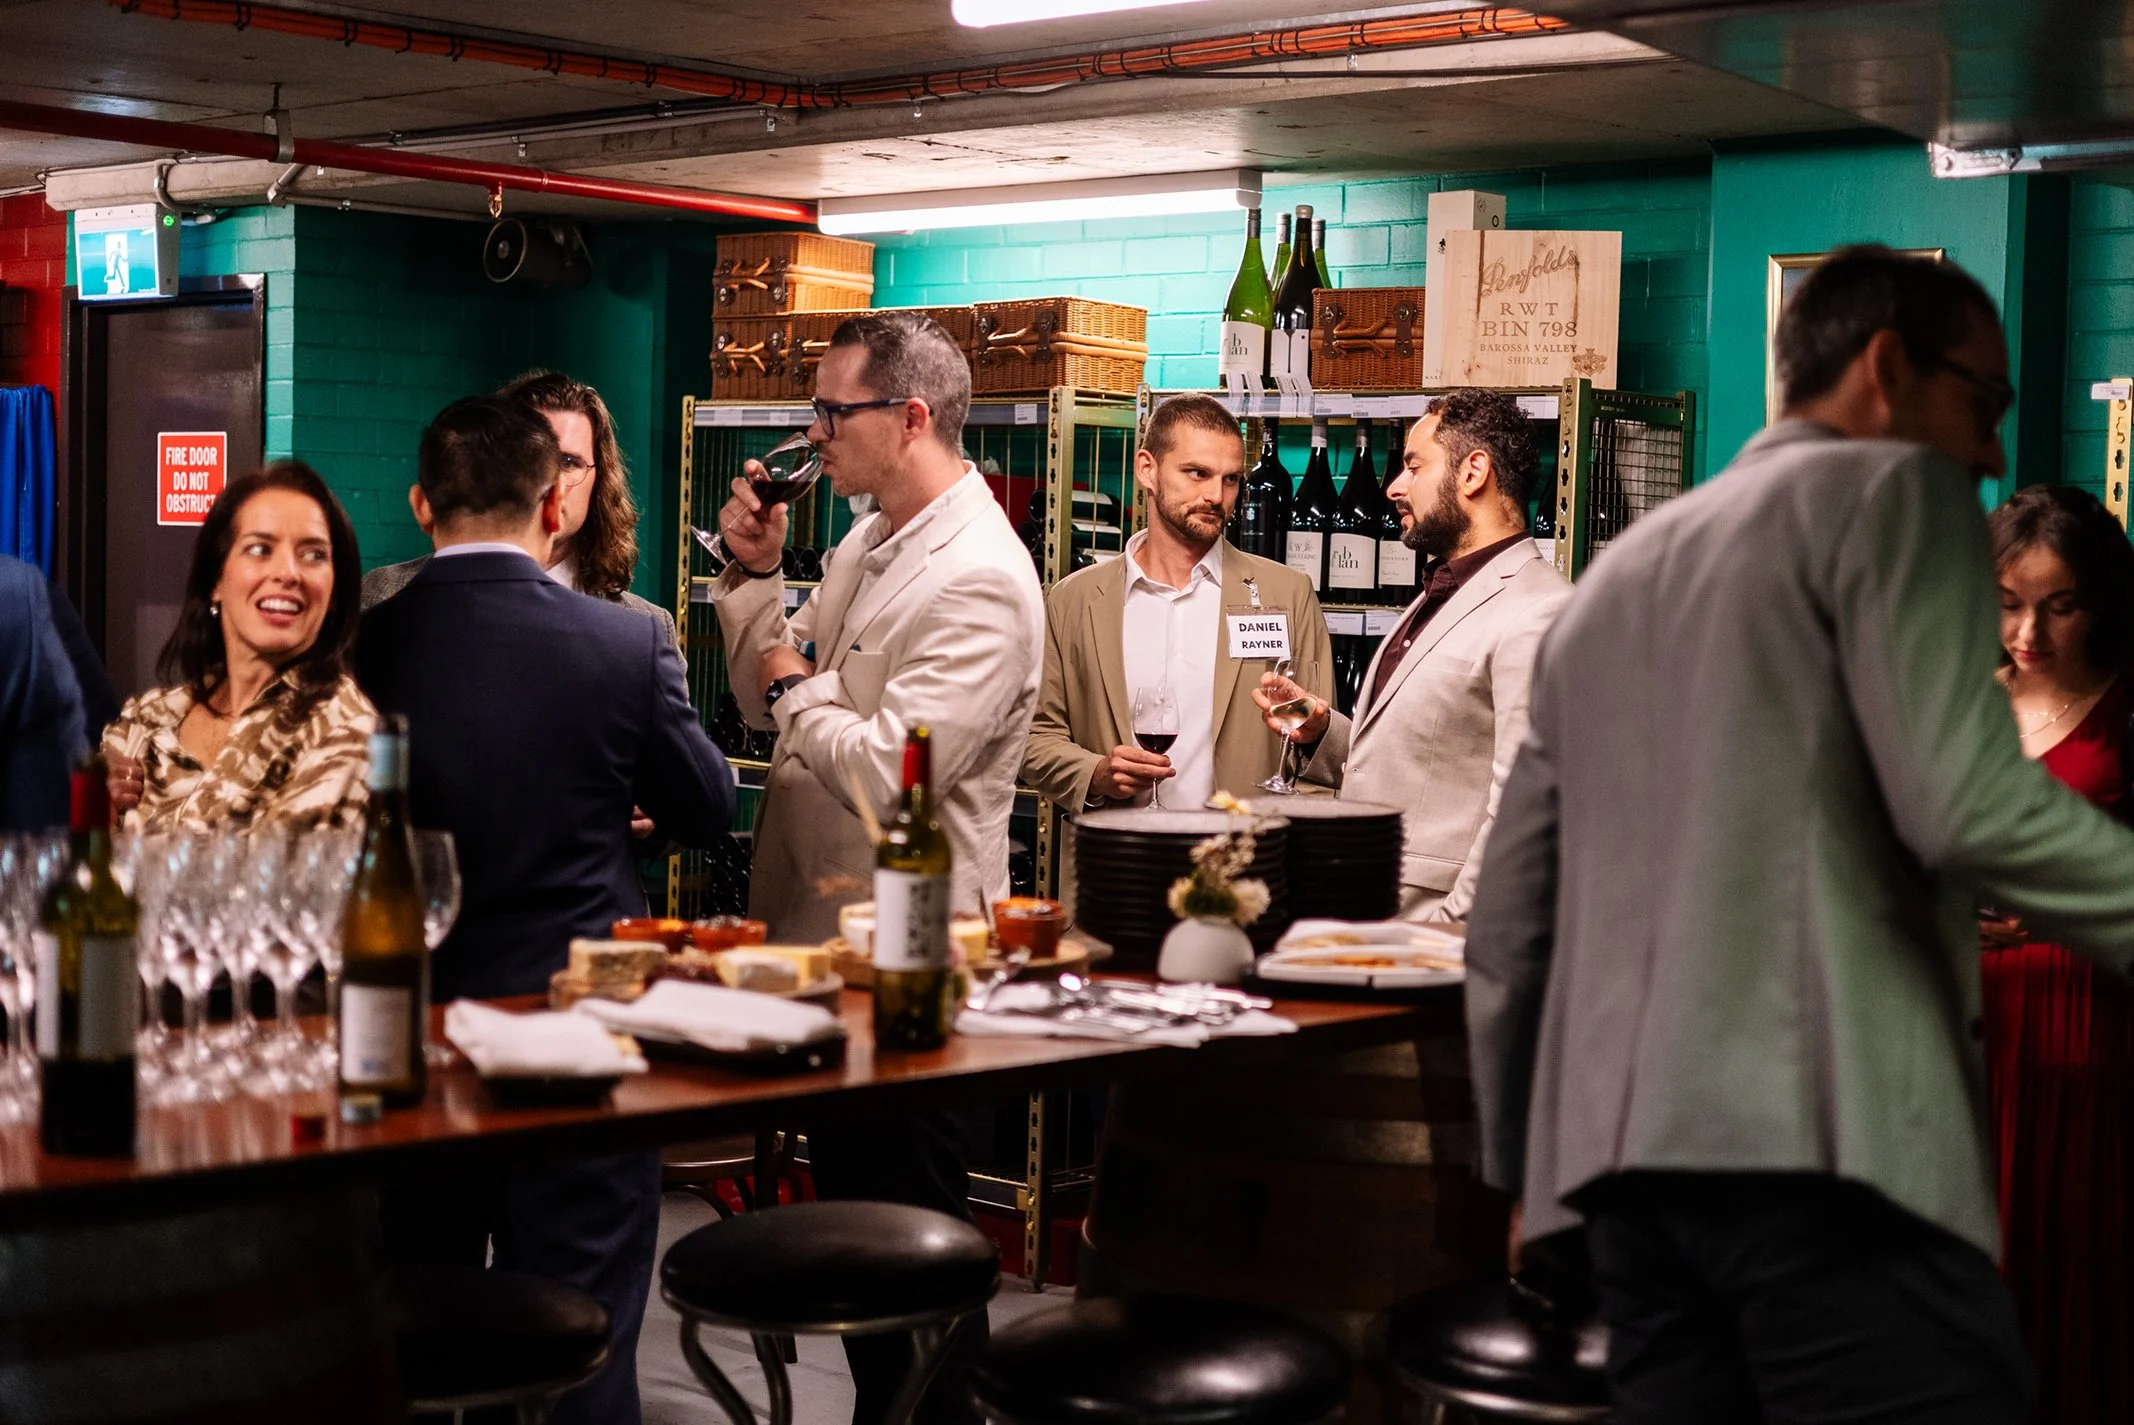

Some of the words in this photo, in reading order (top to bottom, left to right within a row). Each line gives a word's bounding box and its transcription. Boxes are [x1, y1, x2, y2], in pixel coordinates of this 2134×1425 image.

[1481, 245, 1577, 298] Penfolds
[1482, 321, 1529, 337] BIN
[1539, 322, 1577, 337] 798
[1480, 344, 1530, 353] BAROSSA
[1534, 344, 1578, 353] VALLEY
[1507, 357, 1549, 365] SHIRAZ
[165, 446, 188, 466] FIRE
[189, 446, 217, 466] DOOR
[173, 471, 187, 491] DO
[189, 471, 209, 491] NOT
[1239, 622, 1282, 632] DANIEL
[1242, 640, 1283, 649] RAYNER
